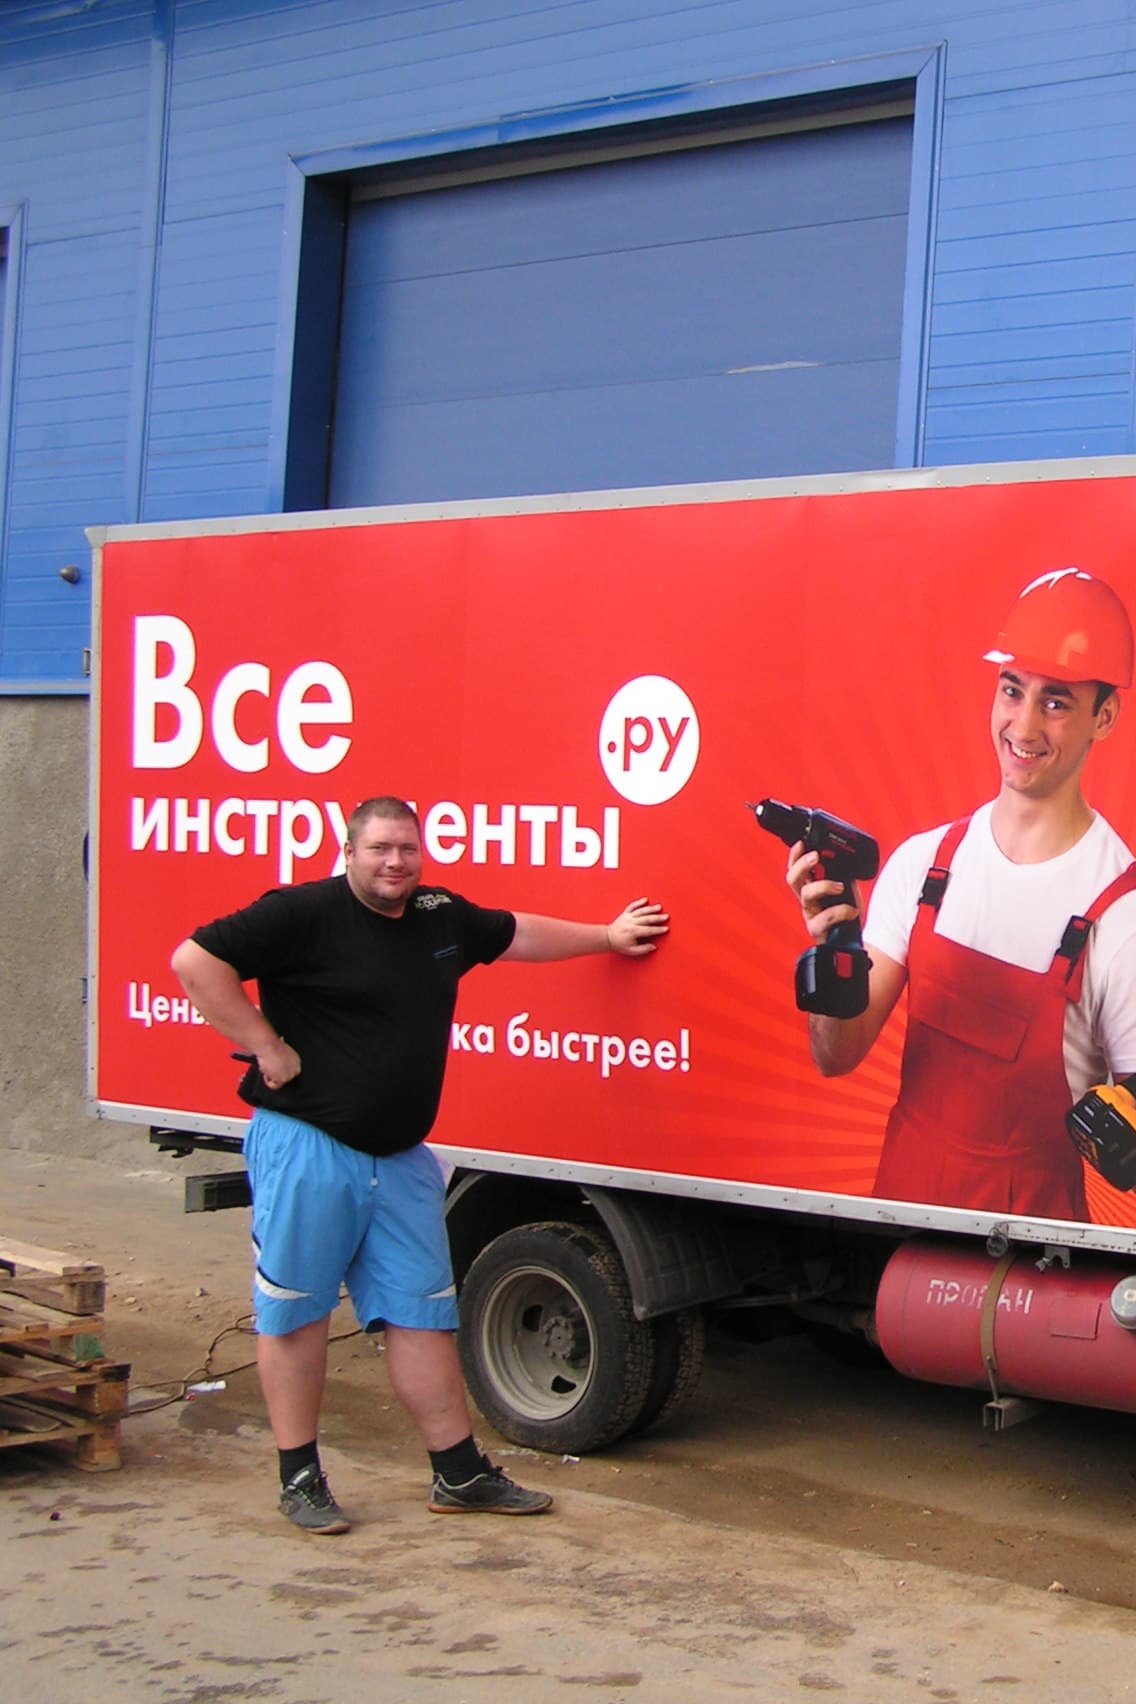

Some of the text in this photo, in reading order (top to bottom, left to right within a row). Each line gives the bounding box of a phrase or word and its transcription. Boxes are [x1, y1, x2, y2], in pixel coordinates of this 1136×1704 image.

[132, 614, 354, 774] Все
[607, 715, 691, 772] .ру
[130, 797, 620, 884] инструенты
[506, 1011, 691, 1079] быстрее!
